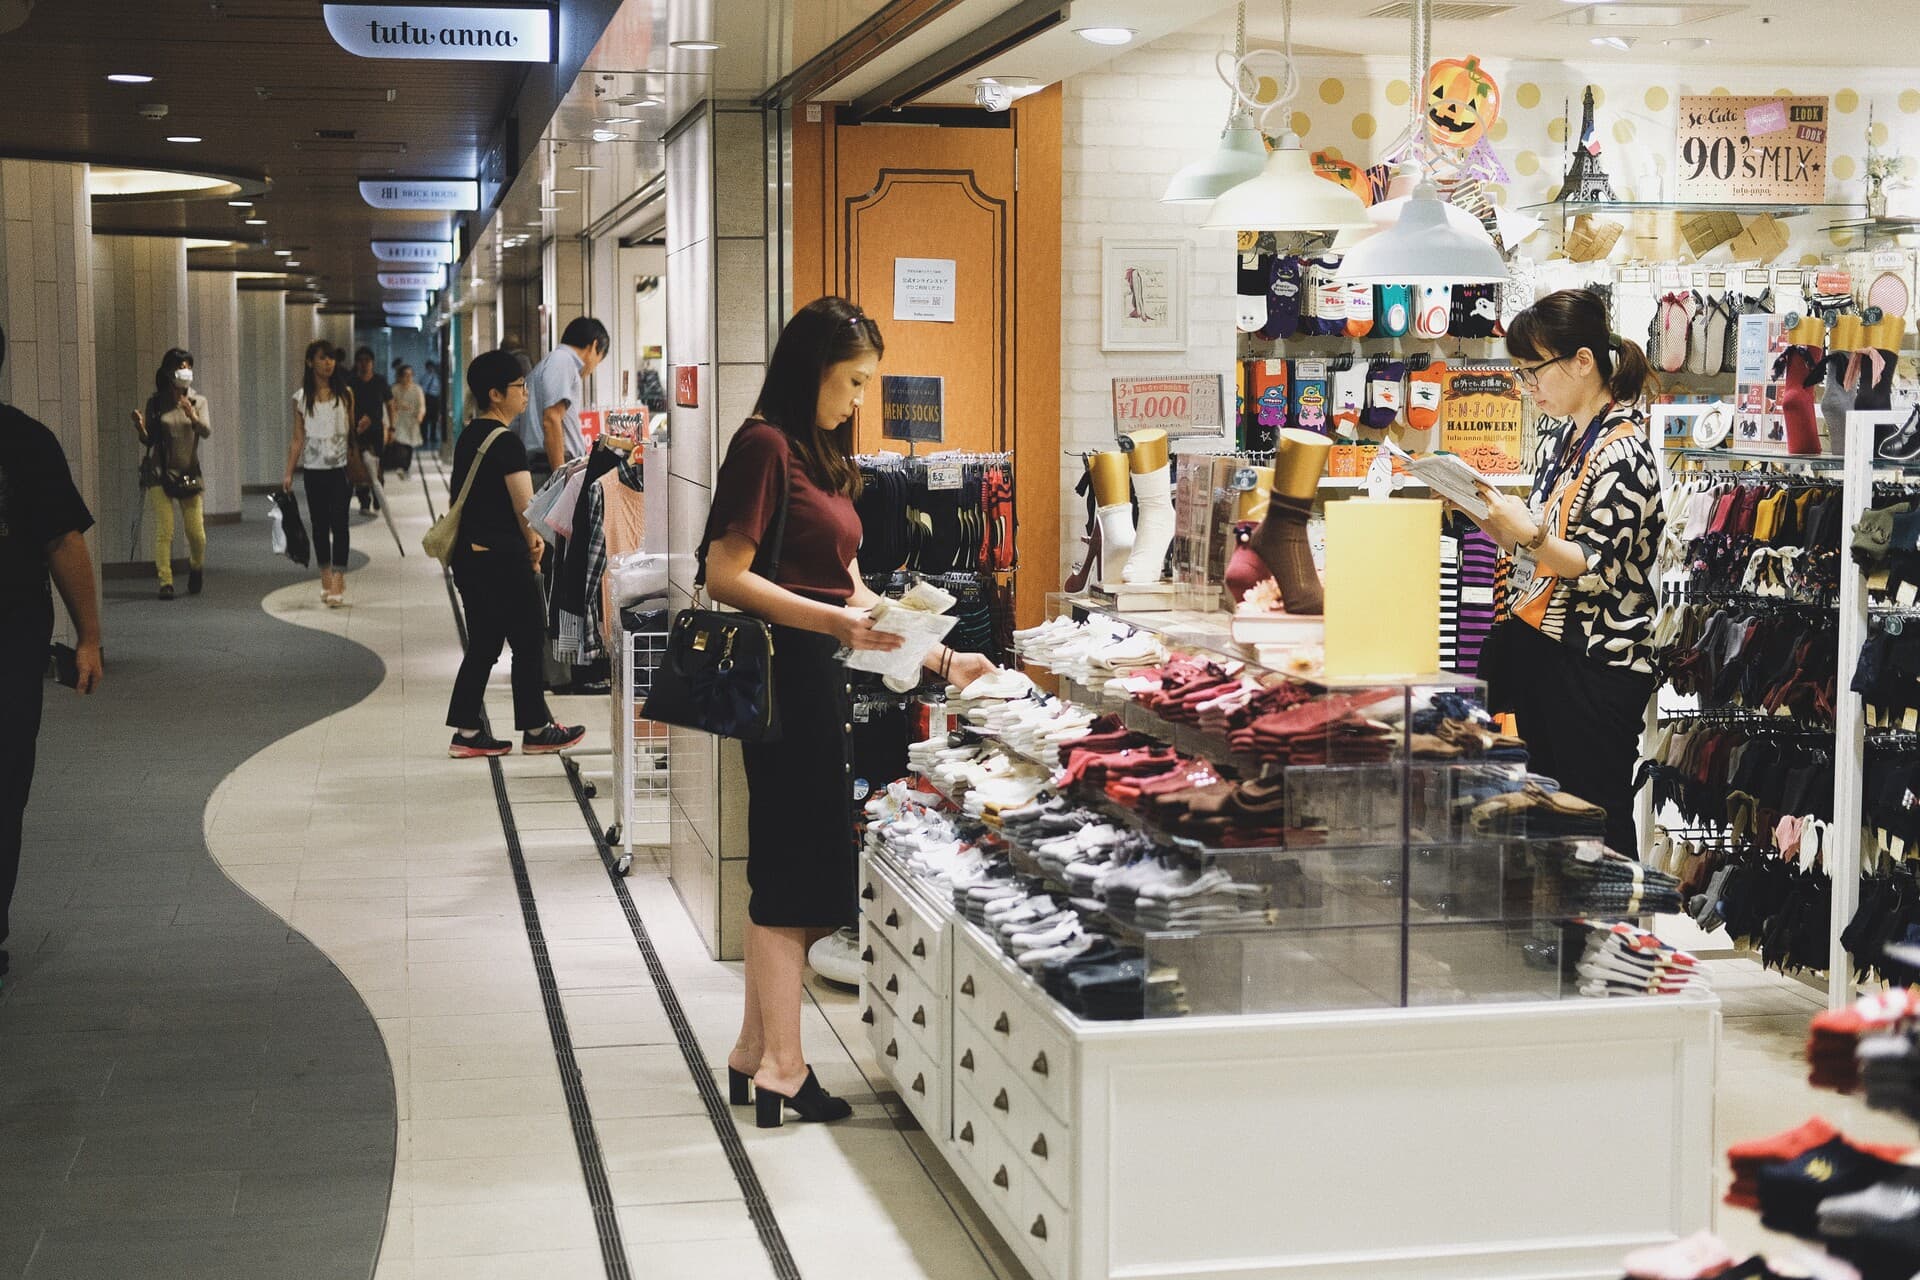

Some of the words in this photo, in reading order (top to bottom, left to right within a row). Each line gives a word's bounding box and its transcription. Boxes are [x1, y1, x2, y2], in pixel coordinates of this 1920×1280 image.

[365, 20, 435, 45] tutu
[438, 27, 518, 47] anna
[1796, 110, 1818, 121] LOOK
[1801, 127, 1822, 142] LOOK
[1760, 147, 1813, 182] MIX
[884, 403, 910, 420] MEN'S
[911, 404, 940, 423] SOCKS
[1447, 420, 1517, 432] HALLOWEEN!
